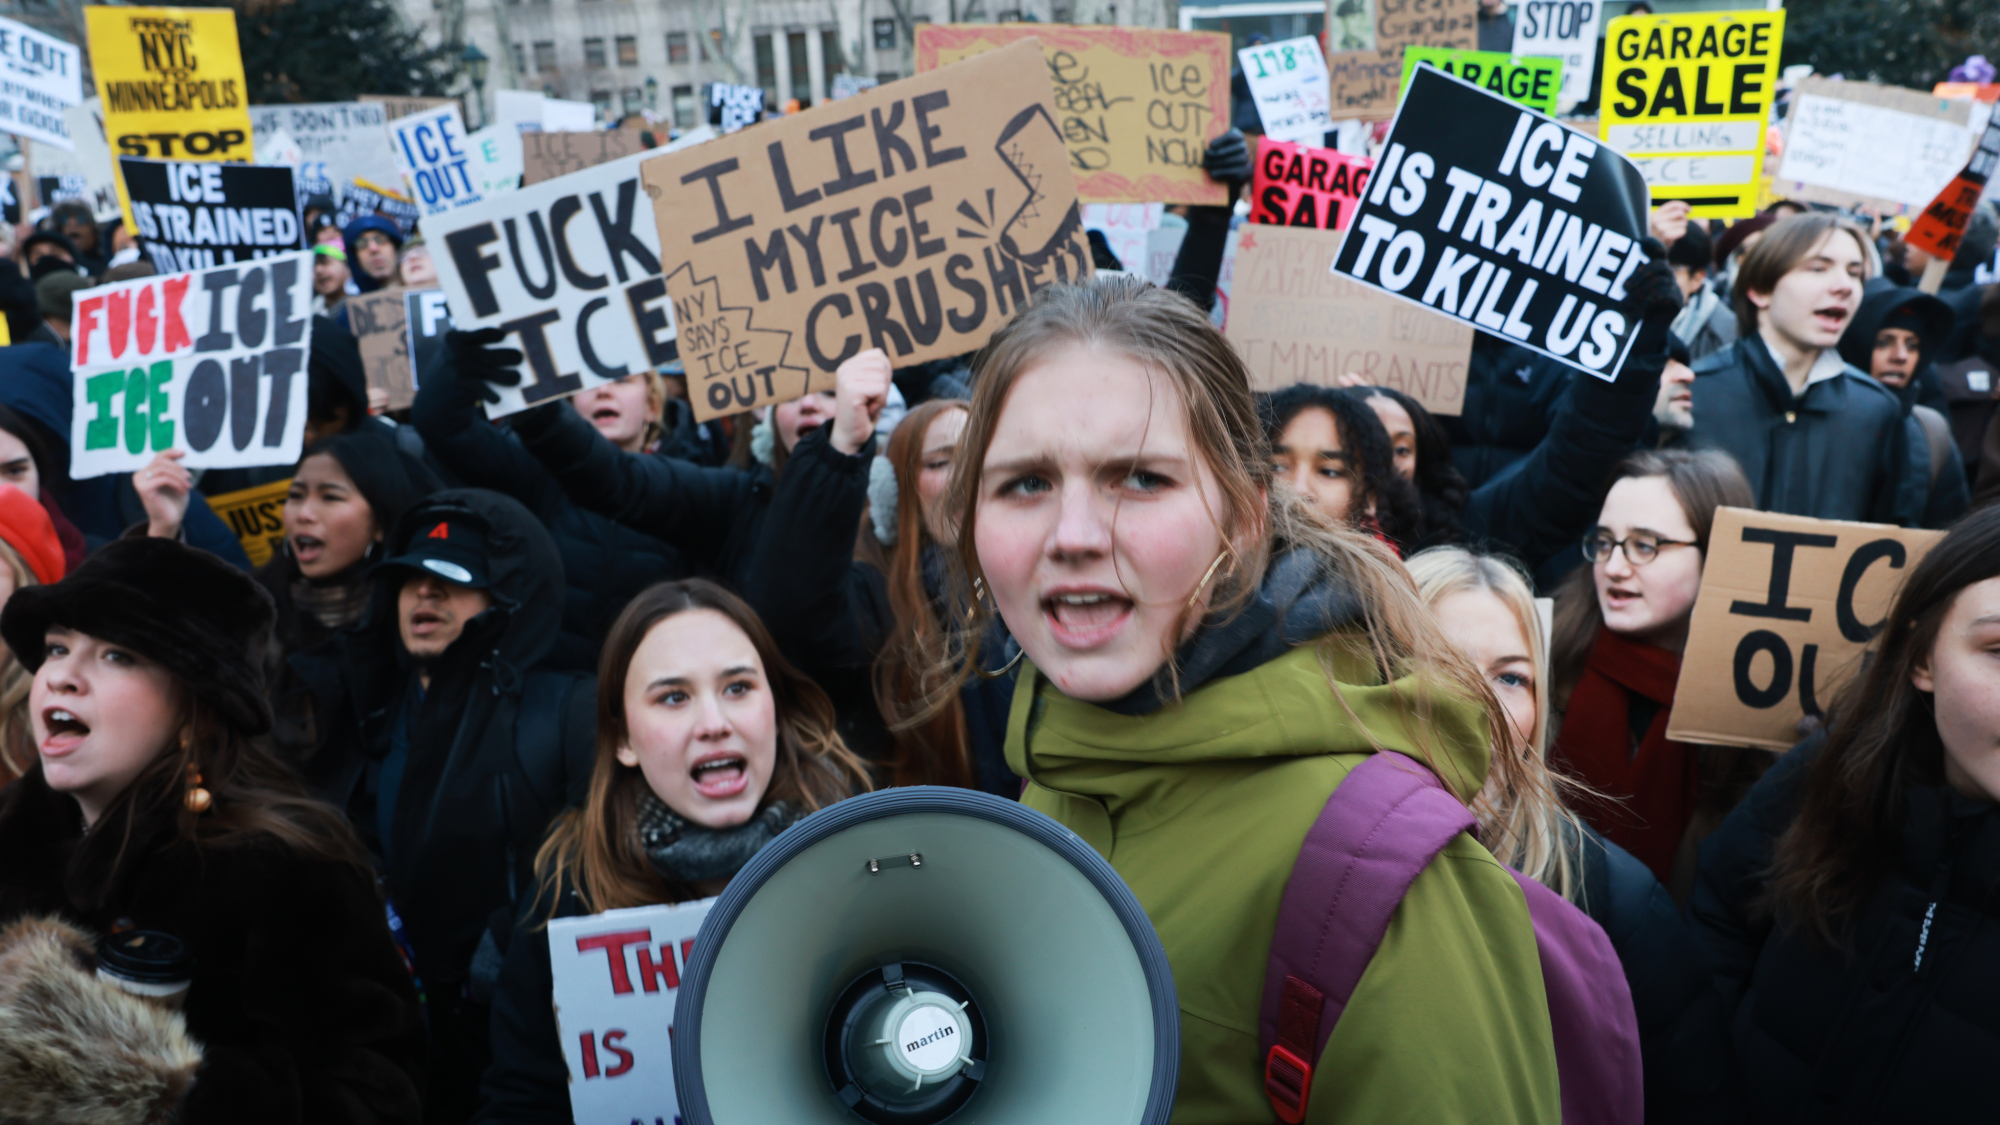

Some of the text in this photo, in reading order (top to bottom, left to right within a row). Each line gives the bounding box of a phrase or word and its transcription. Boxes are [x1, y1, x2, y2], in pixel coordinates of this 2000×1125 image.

[1523, 1, 1592, 39] STOP
[1617, 23, 1771, 61] GARAGE
[139, 32, 197, 71] NYC
[106, 80, 238, 113] MINNEAPOLIS
[160, 70, 188, 82] TO
[711, 83, 763, 107] FUCK
[1420, 60, 1552, 100] RAGE
[1613, 64, 1765, 118] SALE
[1147, 99, 1214, 136] OUT
[1629, 125, 1732, 149] SELLING
[117, 130, 244, 157] STOP
[398, 113, 464, 168] ICE
[530, 133, 578, 160] ICE
[1498, 111, 1598, 203] ICE
[165, 162, 226, 203] ICE
[415, 159, 473, 205] OUT
[680, 90, 967, 244] I LIKE
[1264, 149, 1370, 201] GARAG
[1369, 141, 1435, 217] IS
[131, 201, 299, 246] IS TRAINED
[1259, 186, 1340, 229] SAL
[445, 177, 663, 319] FUCK
[77, 258, 306, 367] FUCK ICE
[675, 290, 705, 324] NY
[1351, 213, 1626, 370] TO KILL US
[500, 278, 680, 405] ICE
[685, 316, 730, 352] SAYS
[697, 340, 758, 380] ICE
[1242, 336, 1466, 401] IMMIGRANTS
[85, 347, 304, 455] ICE OUT
[707, 365, 777, 411] OUT
[227, 498, 286, 540] JUS
[1729, 526, 1907, 643] IC
[1733, 629, 1880, 720] OU
[579, 1028, 635, 1081] IS
[906, 1025, 954, 1052] martin
